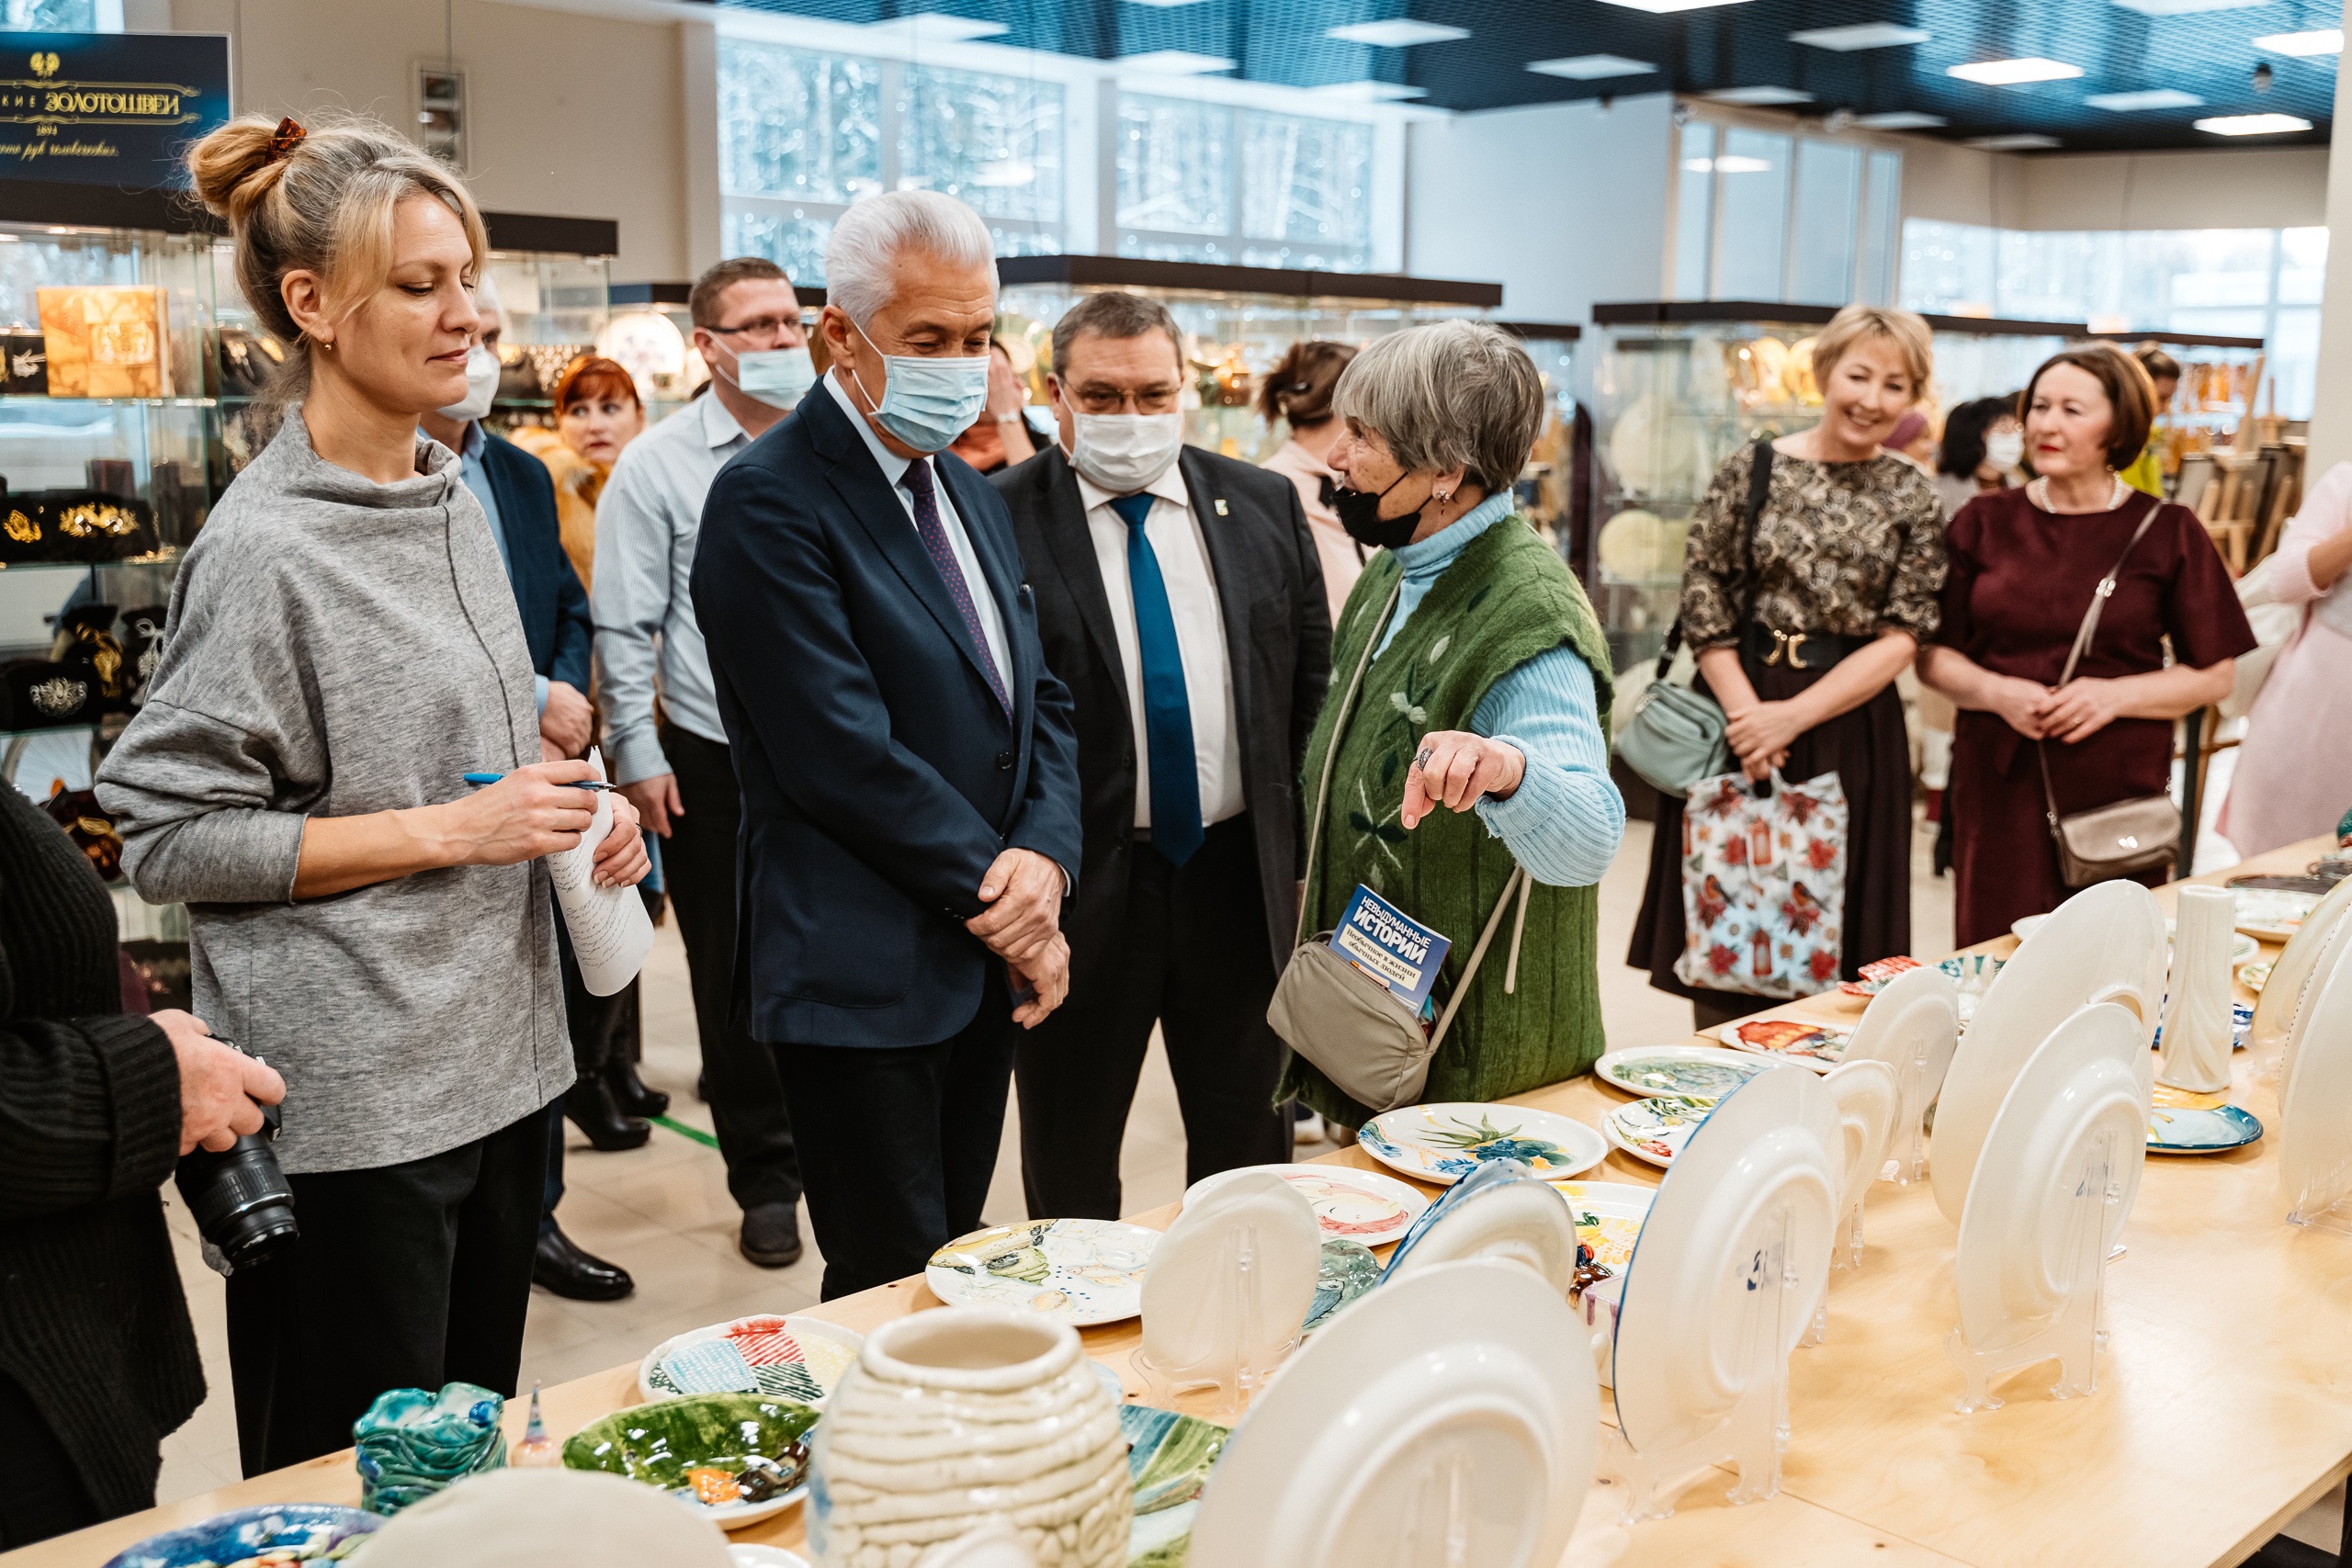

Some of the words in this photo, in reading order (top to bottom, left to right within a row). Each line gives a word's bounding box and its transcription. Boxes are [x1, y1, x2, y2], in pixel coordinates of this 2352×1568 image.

[44, 92, 180, 115] ЗОЛОТОШВЕИ
[1352, 905, 1428, 965] ИСТОРИИ
[1361, 896, 1431, 949] НЕВЫДУМАННЫЕ
[1346, 928, 1383, 957] Необычное
[1388, 959, 1416, 978] жизни
[1349, 941, 1379, 965] обычных
[1380, 964, 1406, 981] людей
